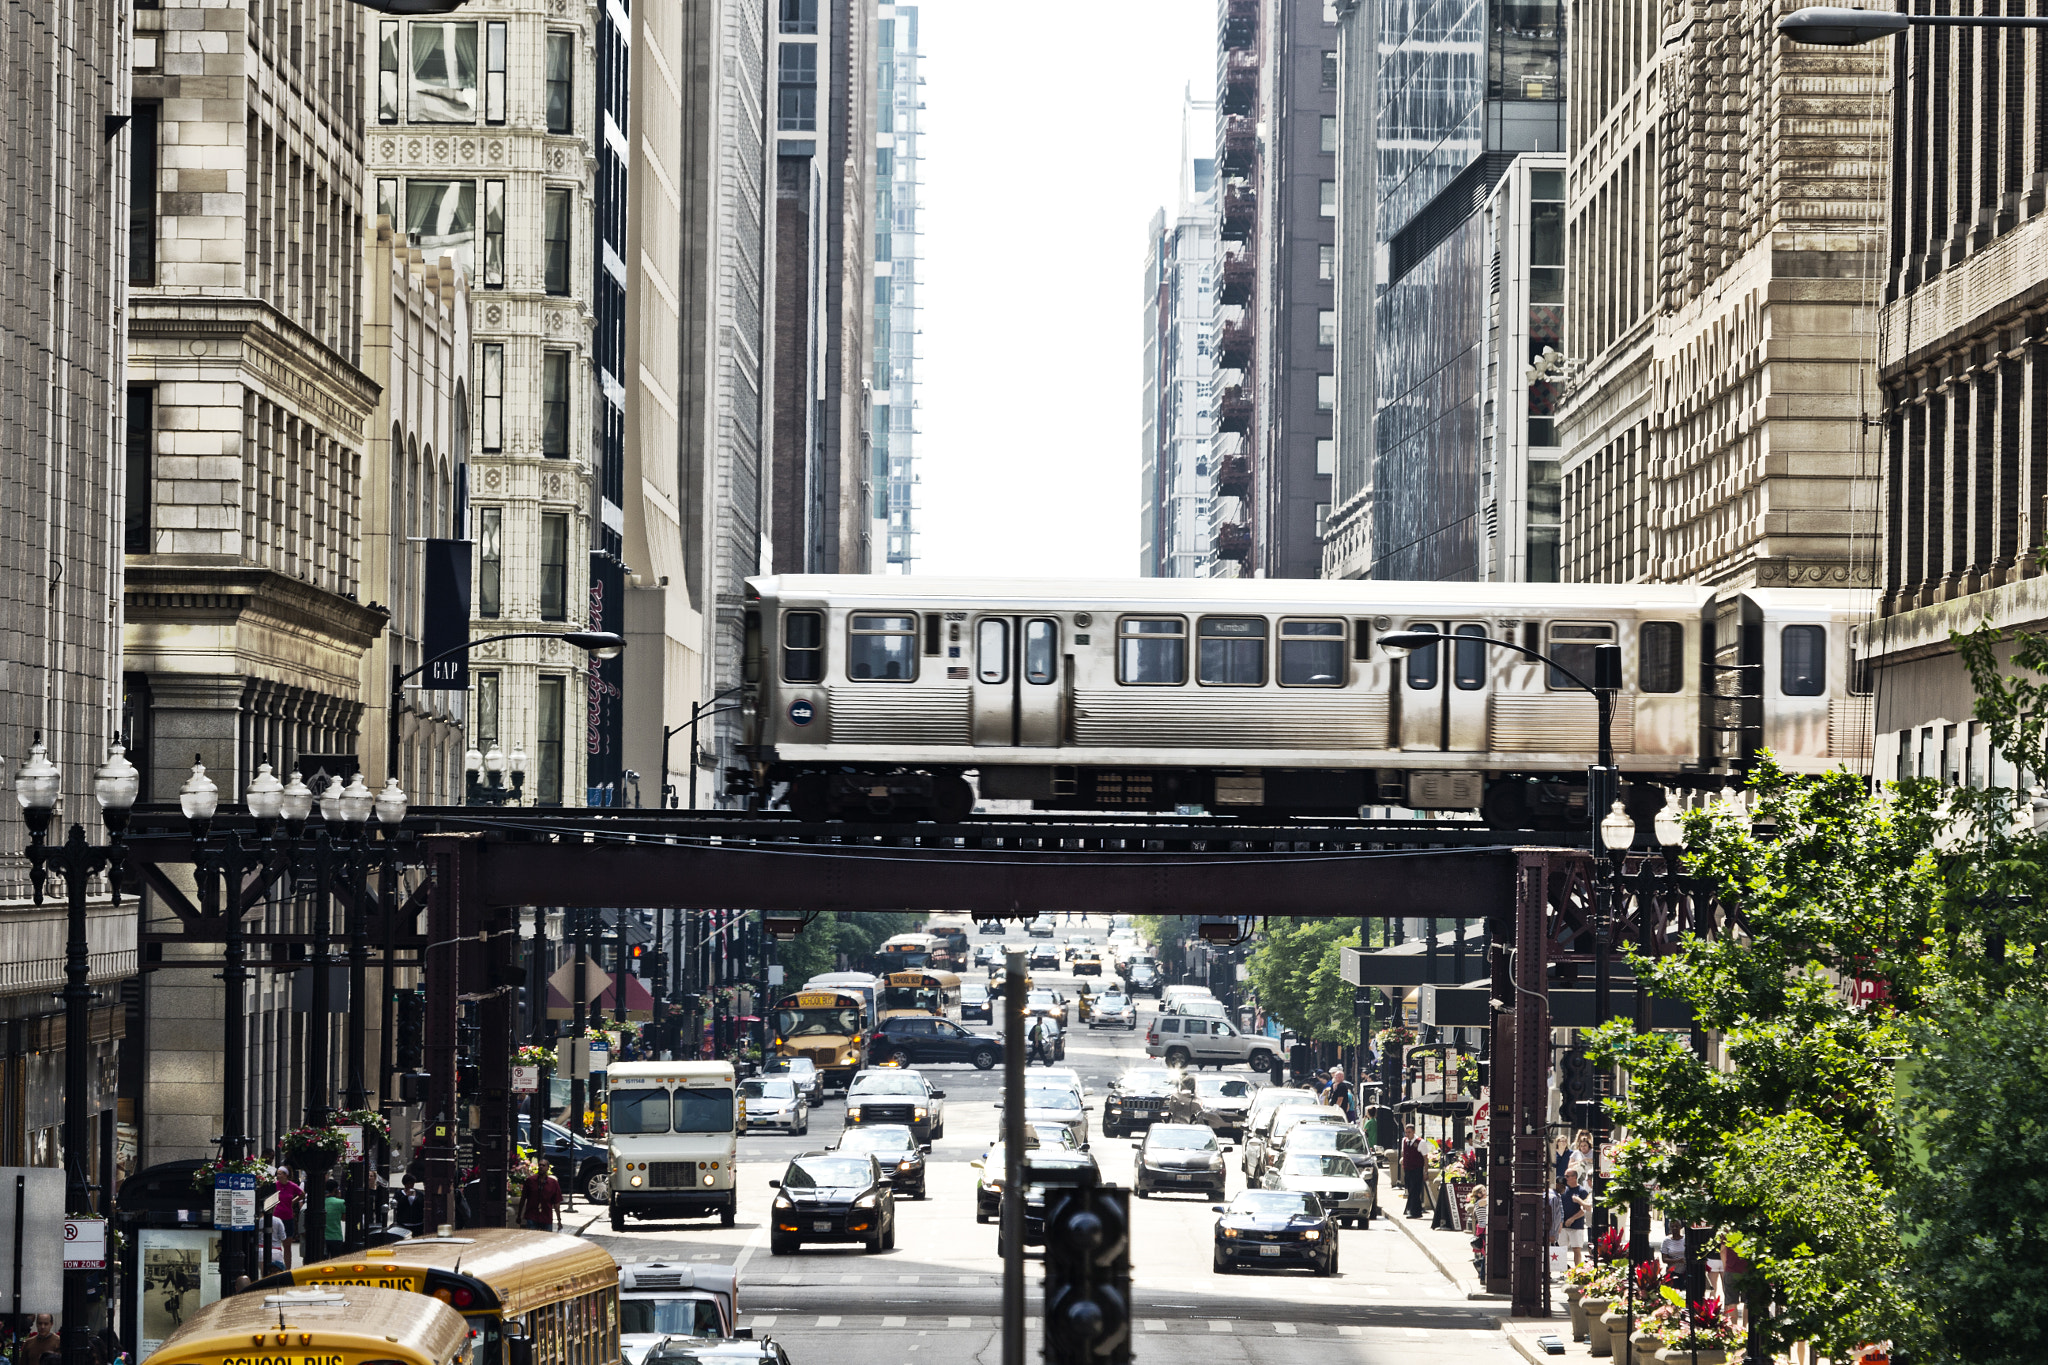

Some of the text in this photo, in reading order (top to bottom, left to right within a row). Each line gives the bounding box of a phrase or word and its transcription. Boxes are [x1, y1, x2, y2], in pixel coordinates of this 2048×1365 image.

[433, 661, 458, 680] GAP
[588, 579, 608, 755] Walgrens
[792, 708, 811, 718] cta
[911, 976, 920, 984] BUS
[801, 996, 834, 1006] SCHOOL BUS
